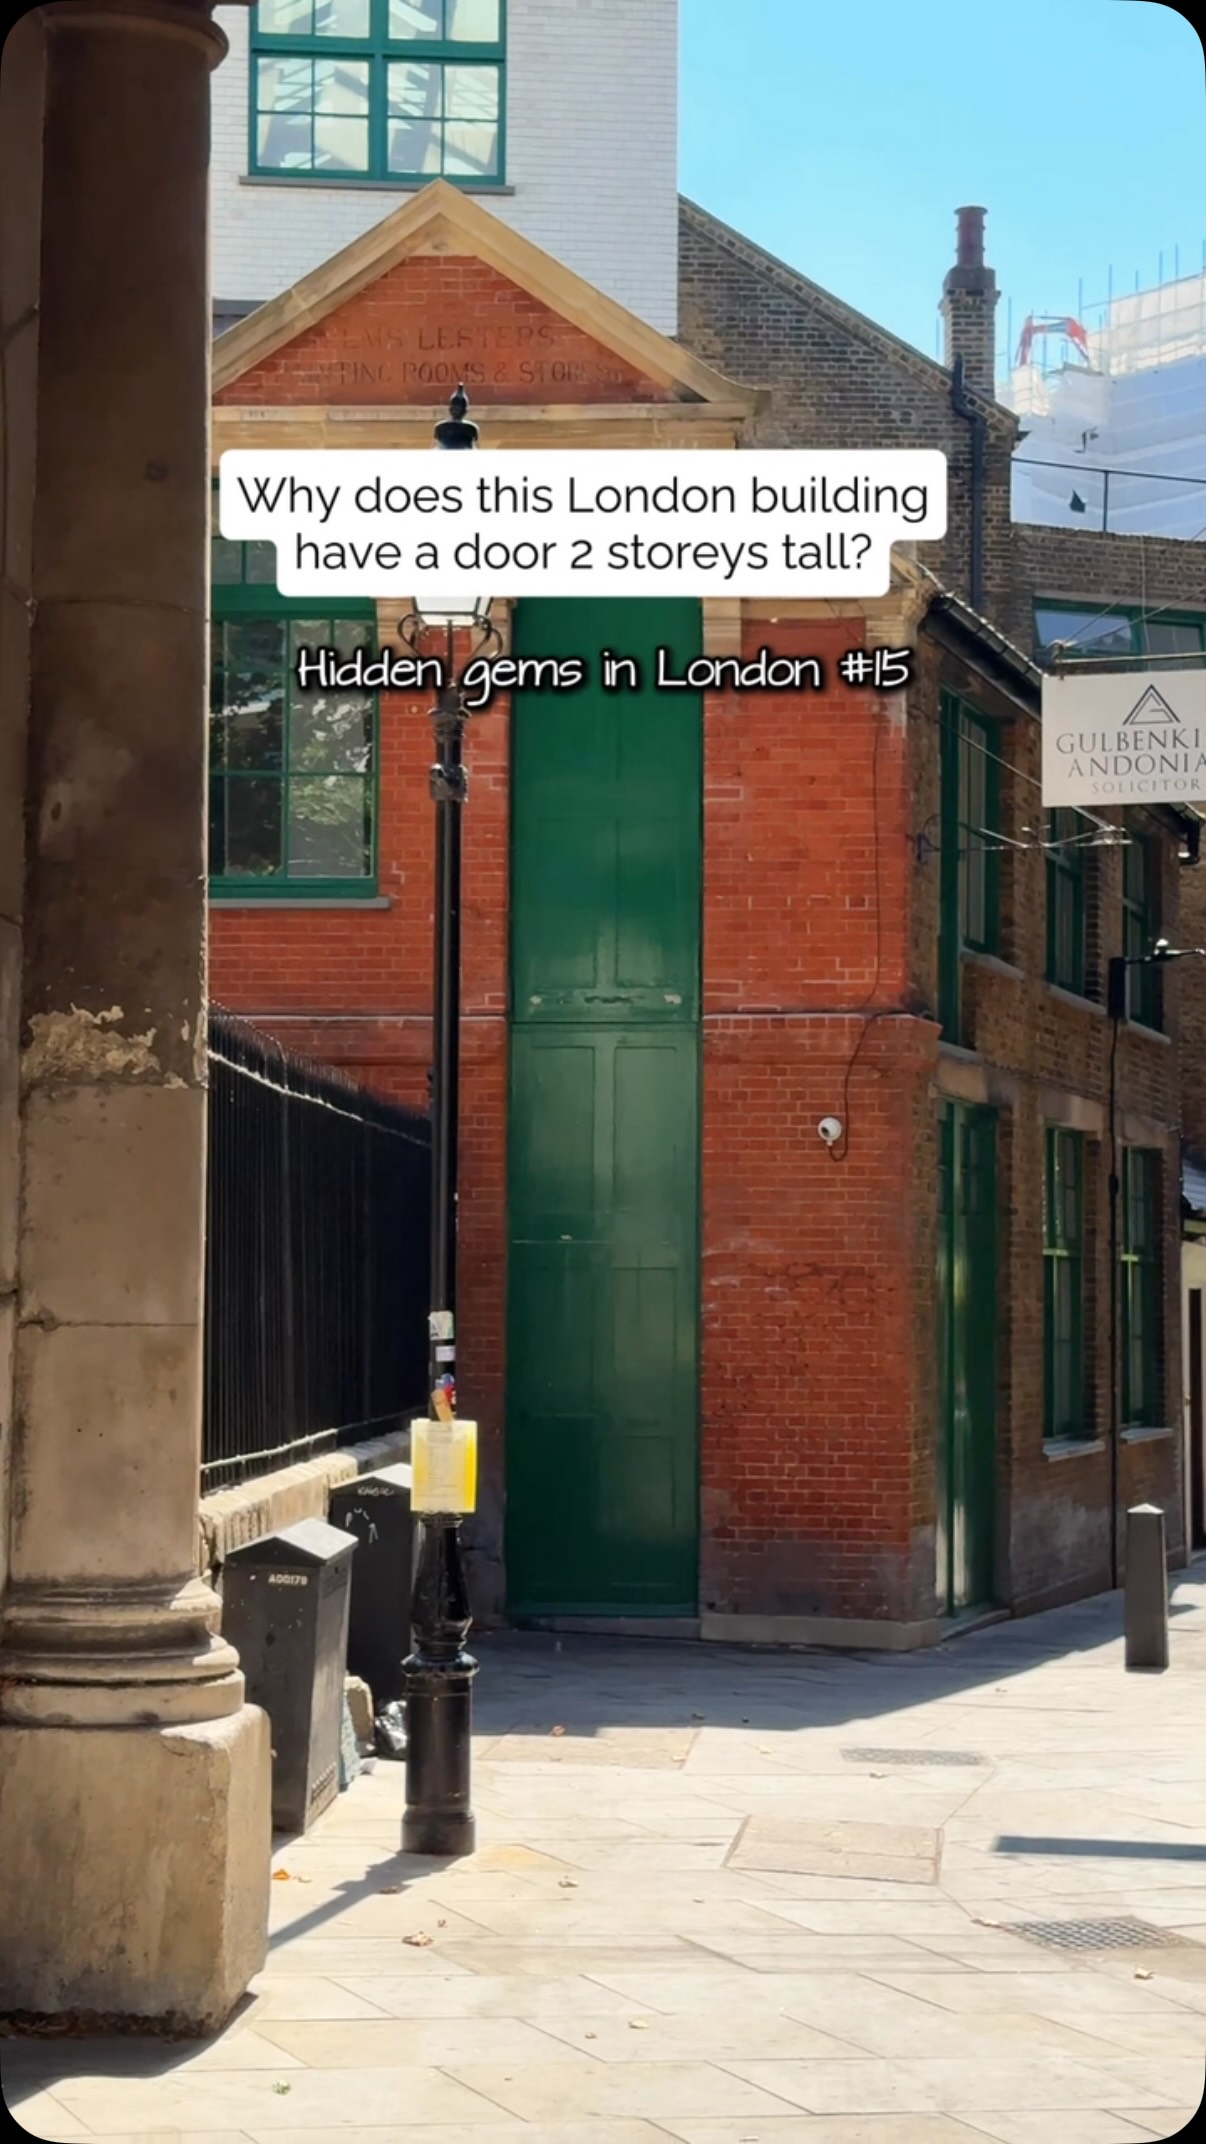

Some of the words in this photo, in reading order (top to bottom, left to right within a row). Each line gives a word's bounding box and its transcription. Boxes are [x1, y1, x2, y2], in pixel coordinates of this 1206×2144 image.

[493, 361, 509, 384] &
[1056, 728, 1206, 754] GULBENKI
[1091, 778, 1201, 794] SOLICITOR
